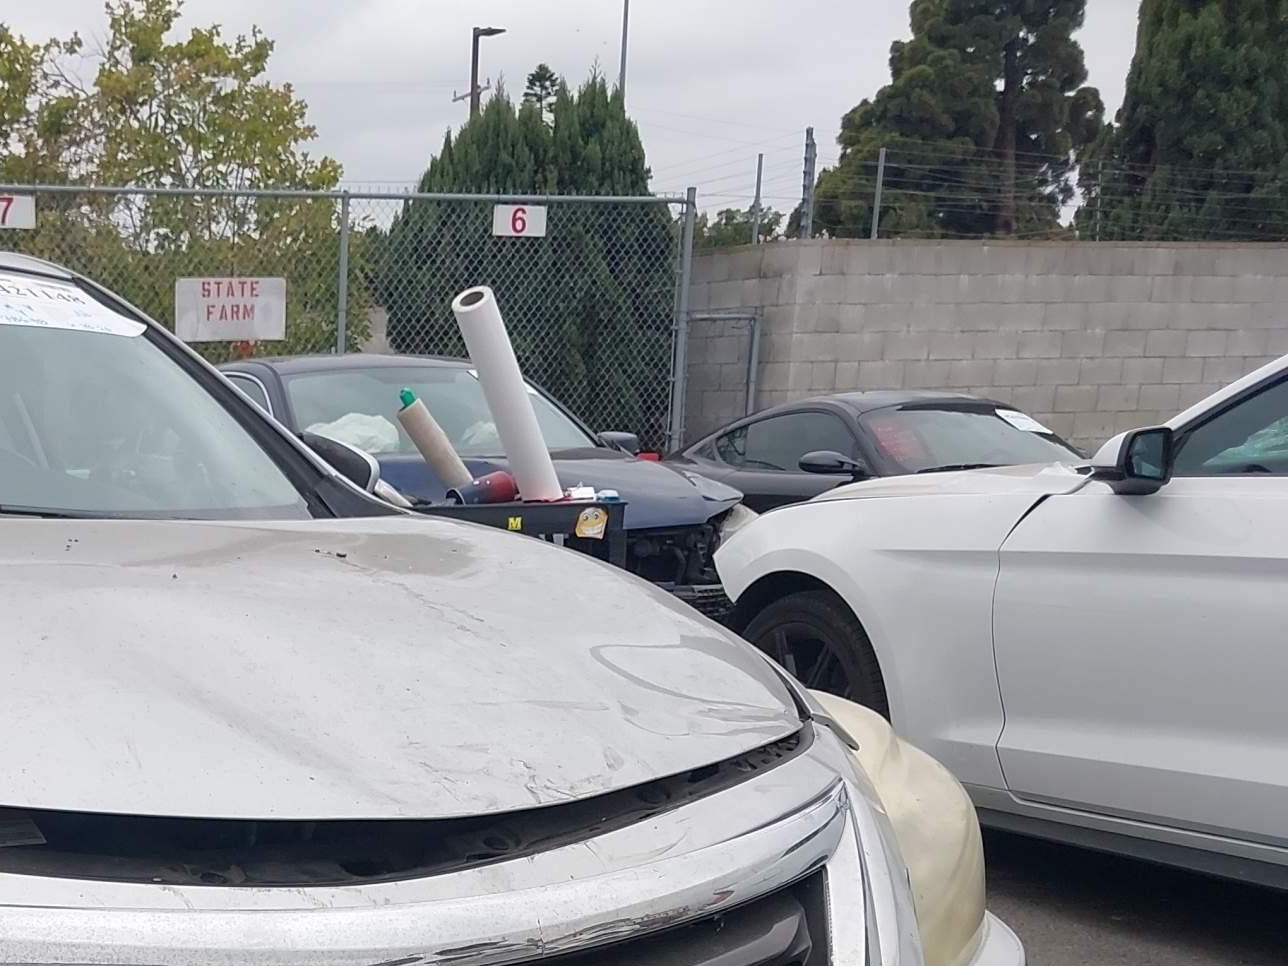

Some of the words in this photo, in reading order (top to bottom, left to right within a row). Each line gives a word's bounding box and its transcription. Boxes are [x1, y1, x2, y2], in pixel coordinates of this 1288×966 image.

[512, 208, 527, 233] 6
[201, 281, 260, 298] STATE
[206, 304, 255, 320] FARM
[508, 517, 523, 530] M
